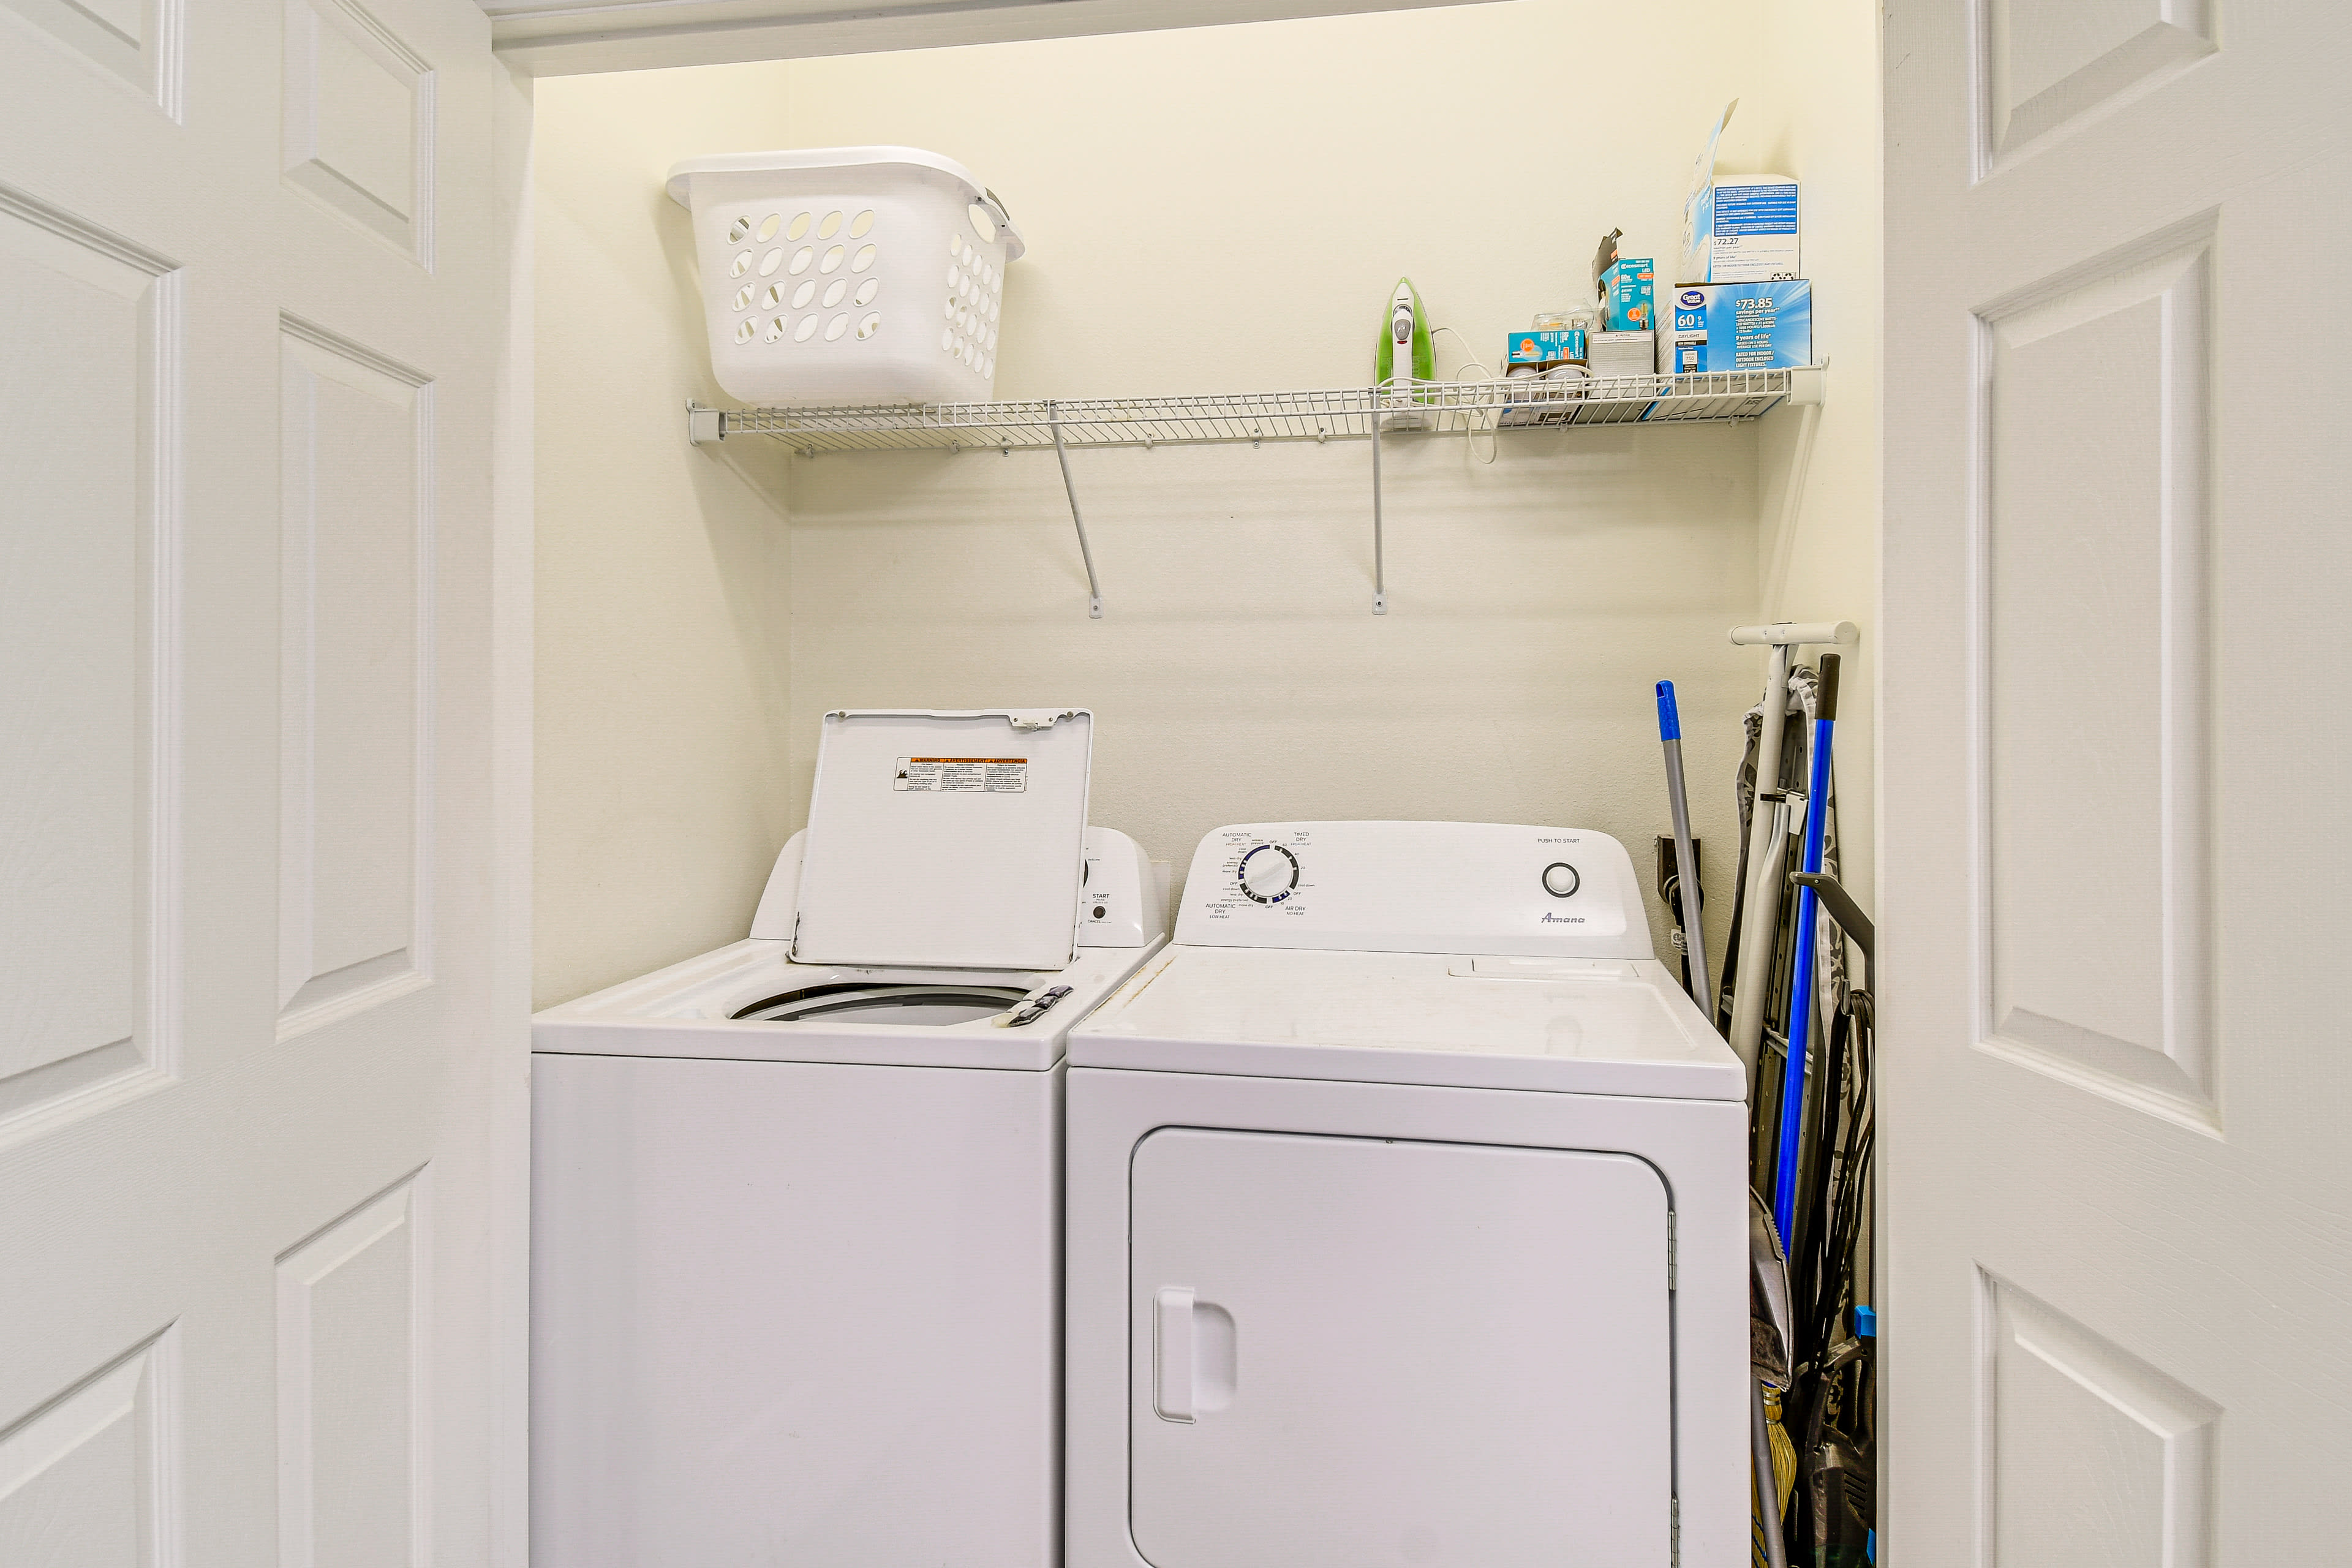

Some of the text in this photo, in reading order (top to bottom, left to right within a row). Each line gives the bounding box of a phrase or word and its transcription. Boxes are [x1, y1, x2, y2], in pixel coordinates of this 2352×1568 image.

[1735, 297, 1773, 309] $73.85
[1678, 314, 1695, 326] 60
[1541, 912, 1585, 923] Amana
